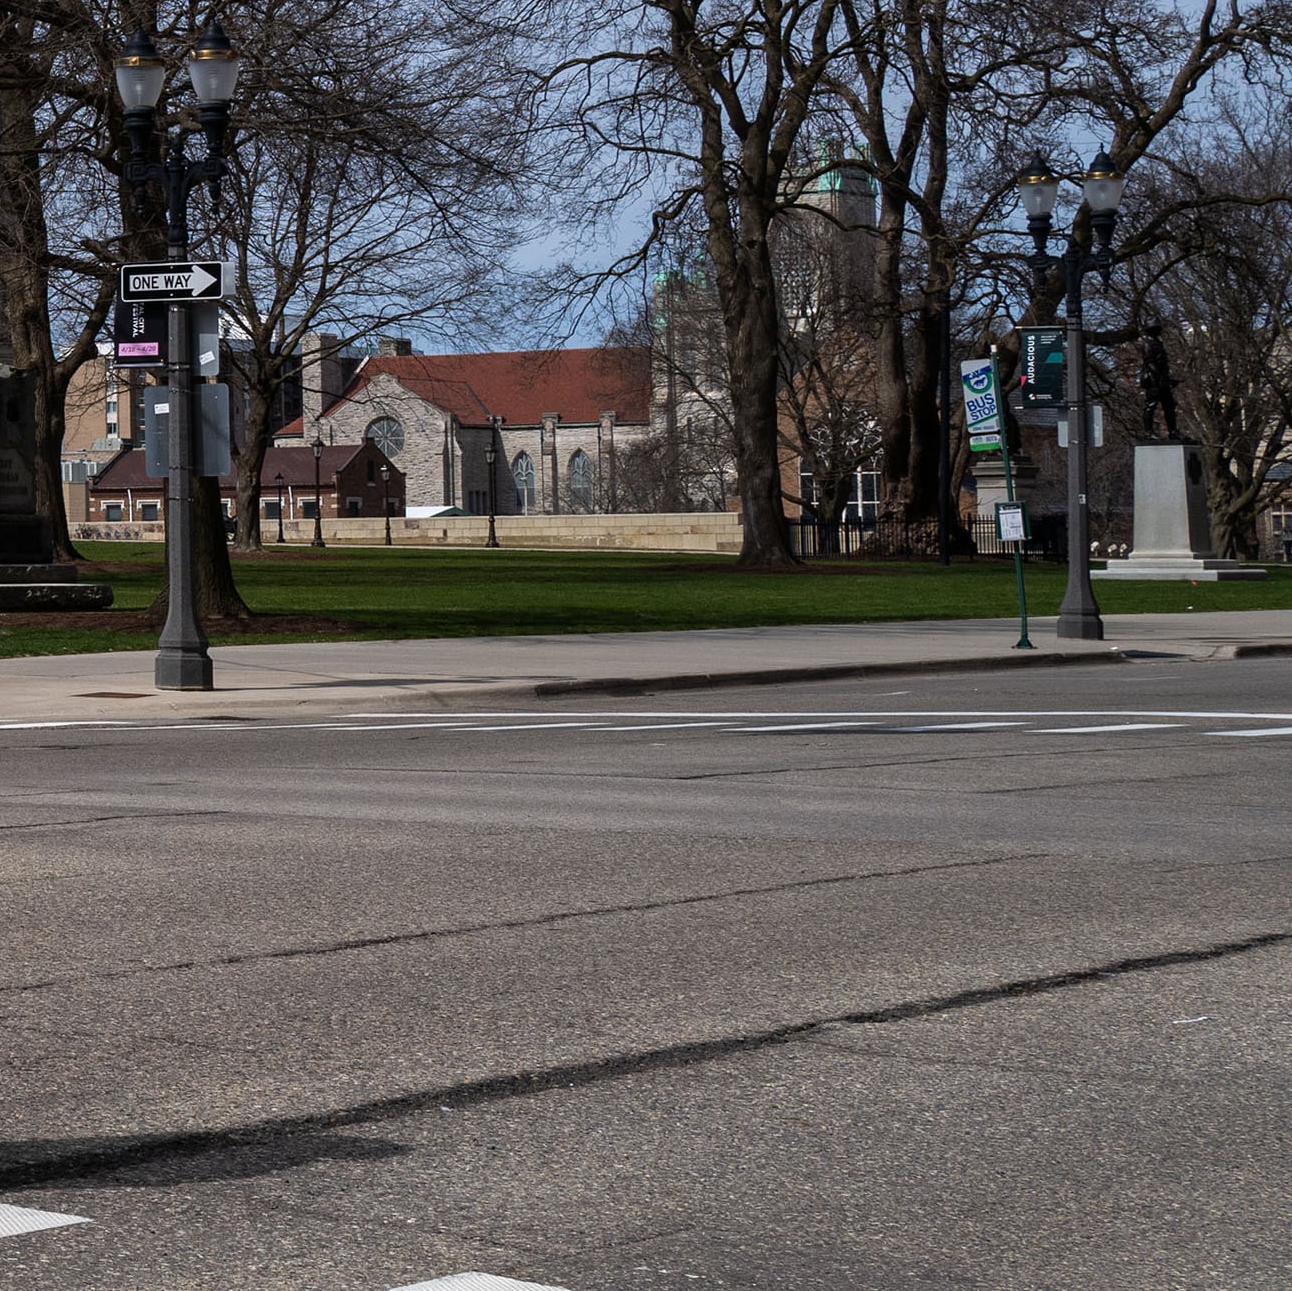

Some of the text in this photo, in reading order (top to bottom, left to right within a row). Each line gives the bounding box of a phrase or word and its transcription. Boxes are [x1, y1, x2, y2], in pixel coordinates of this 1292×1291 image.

[132, 274, 192, 290] ONE WAY
[1027, 335, 1035, 385] AUDACIOUS
[966, 393, 995, 412] BUS
[970, 403, 996, 421] STOP
